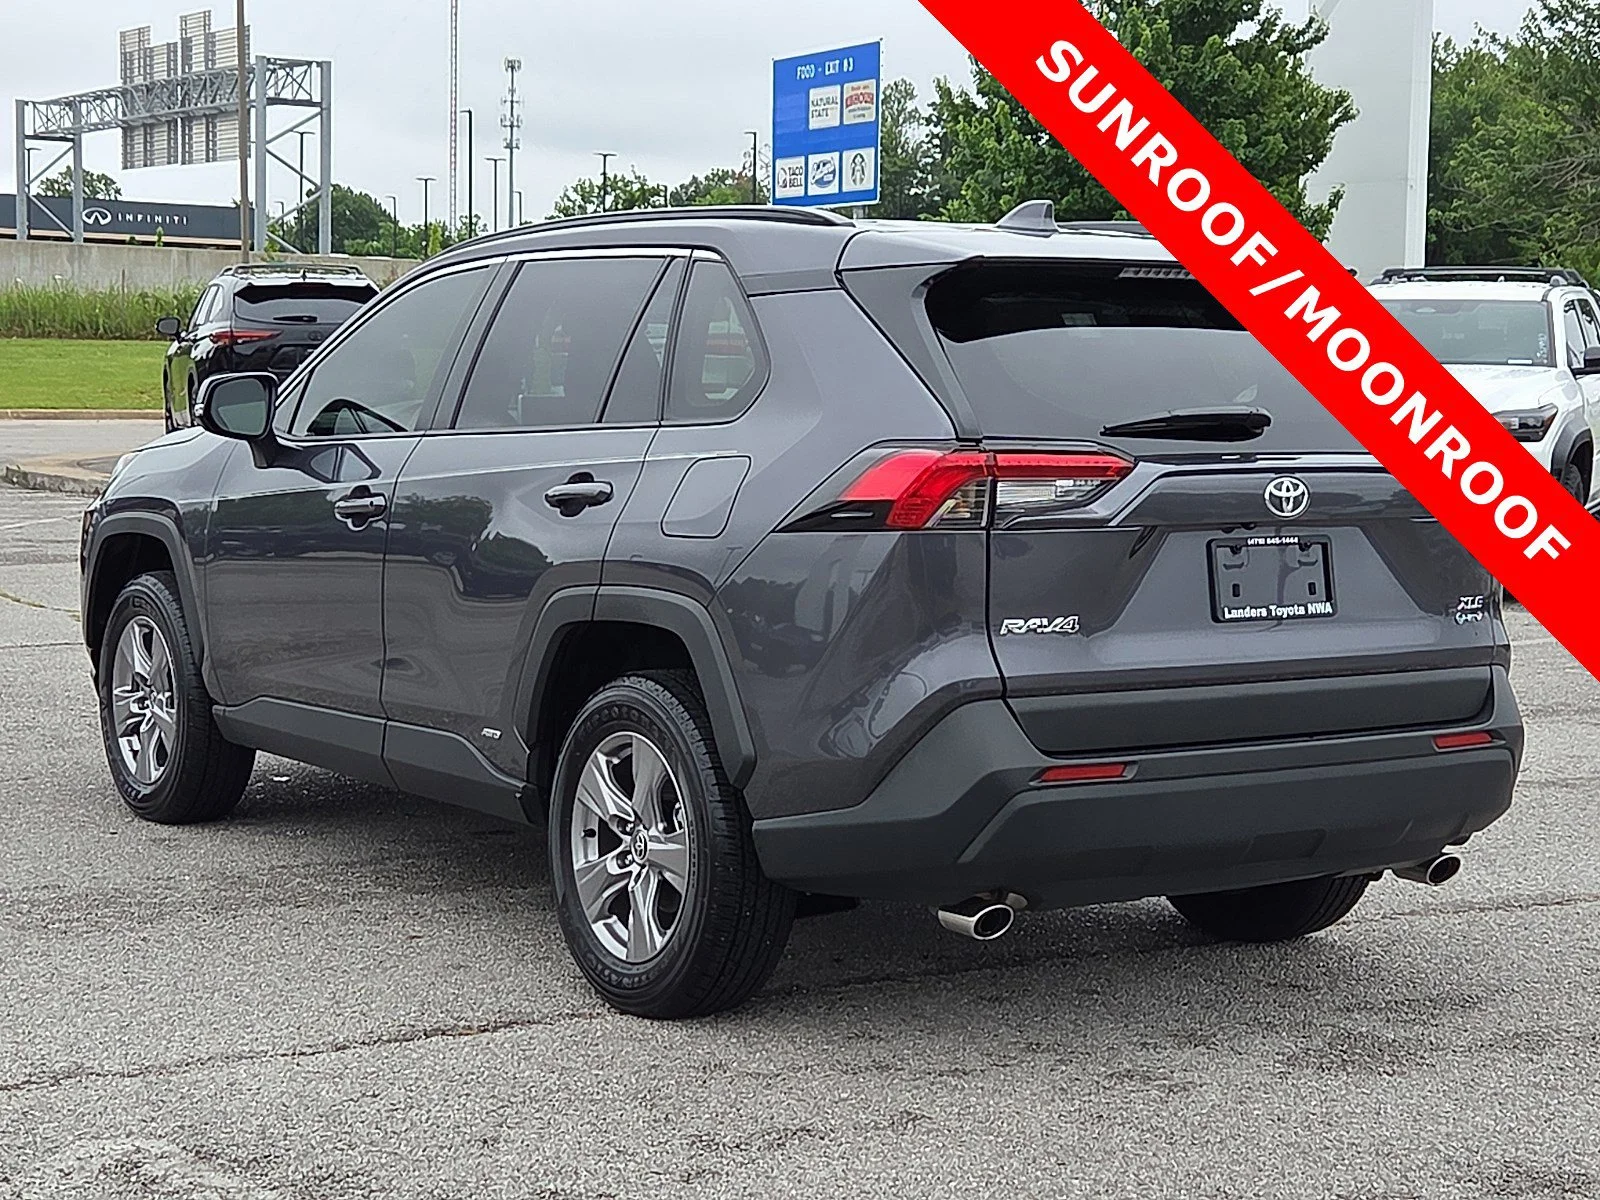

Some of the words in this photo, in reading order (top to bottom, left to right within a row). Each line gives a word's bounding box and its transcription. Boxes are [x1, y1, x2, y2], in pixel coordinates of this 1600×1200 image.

[796, 64, 816, 80] FOOD
[825, 60, 840, 75] EXIT
[811, 96, 838, 107] NATURAL
[811, 108, 829, 118] STATE
[788, 166, 803, 177] TACO
[788, 178, 803, 188] BELL
[118, 212, 187, 225] INFINITI
[1224, 606, 1267, 619] Landers
[1269, 604, 1305, 618] Toyota
[1307, 602, 1332, 614] NWA
[1000, 615, 1080, 634] RAV4
